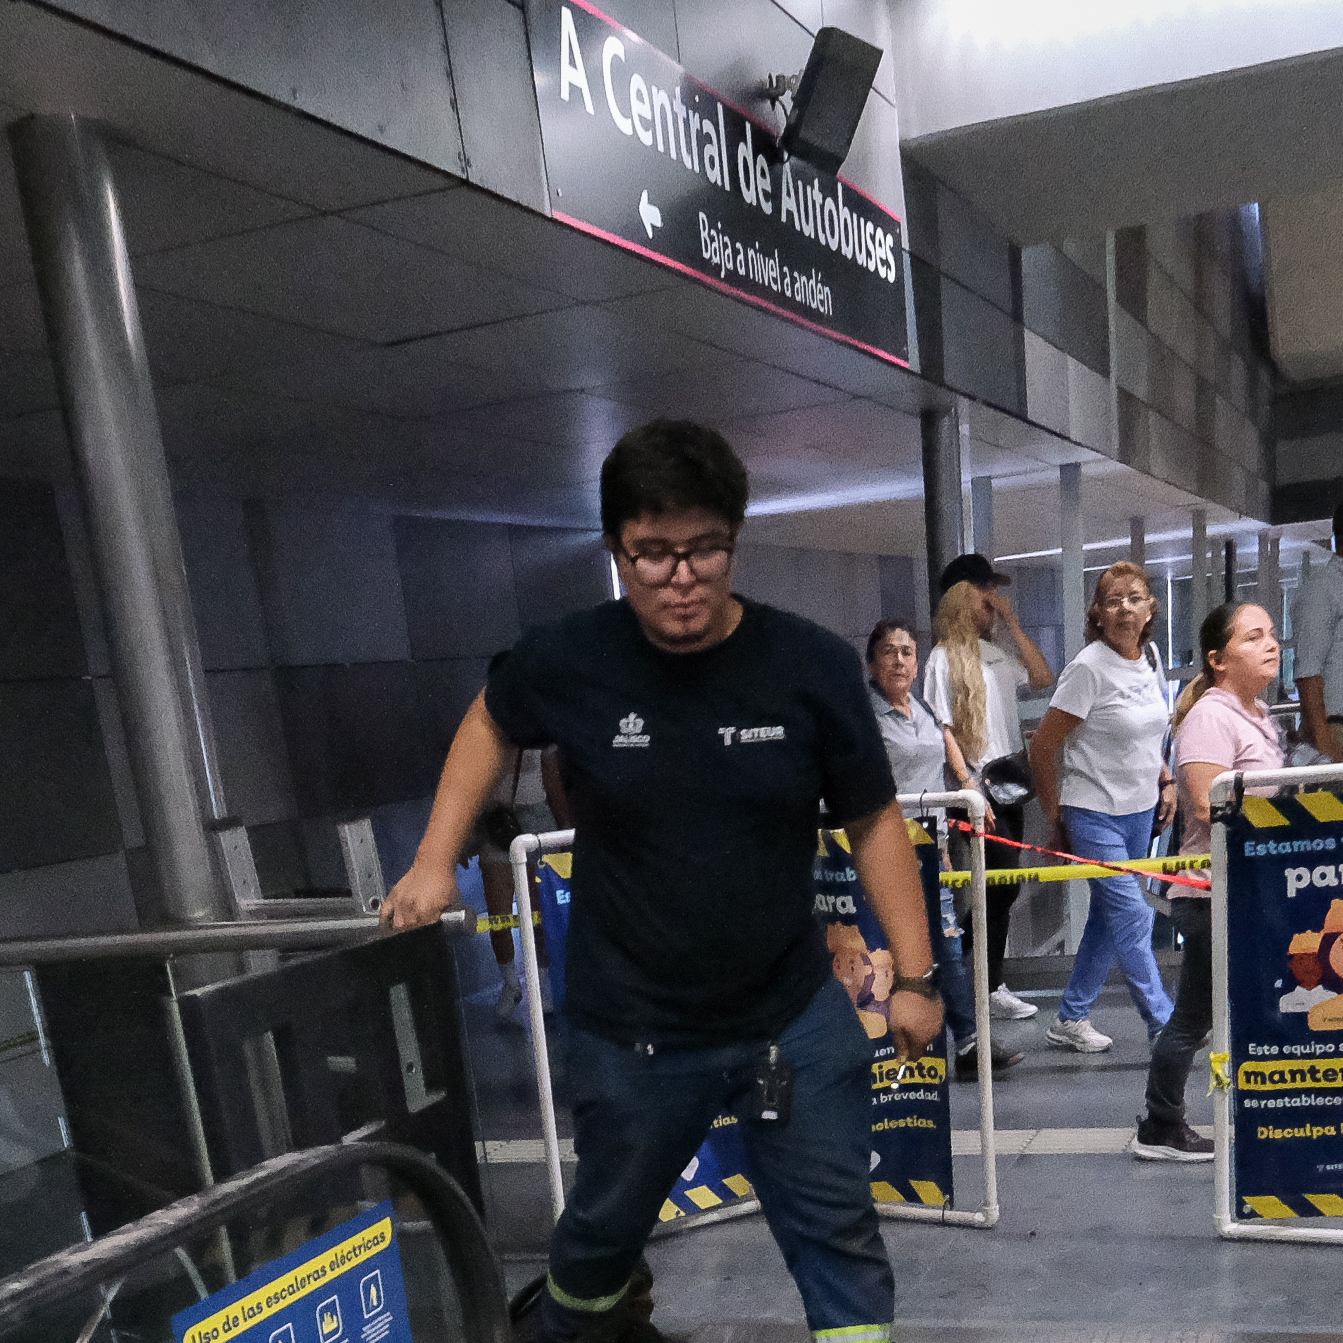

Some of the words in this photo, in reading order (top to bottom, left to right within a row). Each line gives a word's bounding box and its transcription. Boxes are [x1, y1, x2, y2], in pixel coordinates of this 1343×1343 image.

[560, 6, 594, 115] A
[602, 36, 730, 191] Central
[737, 121, 773, 215] de
[781, 150, 896, 283] Autobuses
[699, 212, 733, 278] Baja
[736, 242, 745, 275] a
[748, 241, 781, 292] nivel
[783, 266, 792, 297] a
[793, 268, 832, 316] andén
[1244, 836, 1337, 857] Estamos
[1248, 1042, 1279, 1056] Este
[1282, 1041, 1335, 1057] equipo
[1257, 1122, 1336, 1140] Disculpa
[222, 1314, 239, 1334] de
[242, 1301, 264, 1323] las
[265, 1267, 327, 1308] escaleras
[328, 1231, 386, 1272] eléctricas
